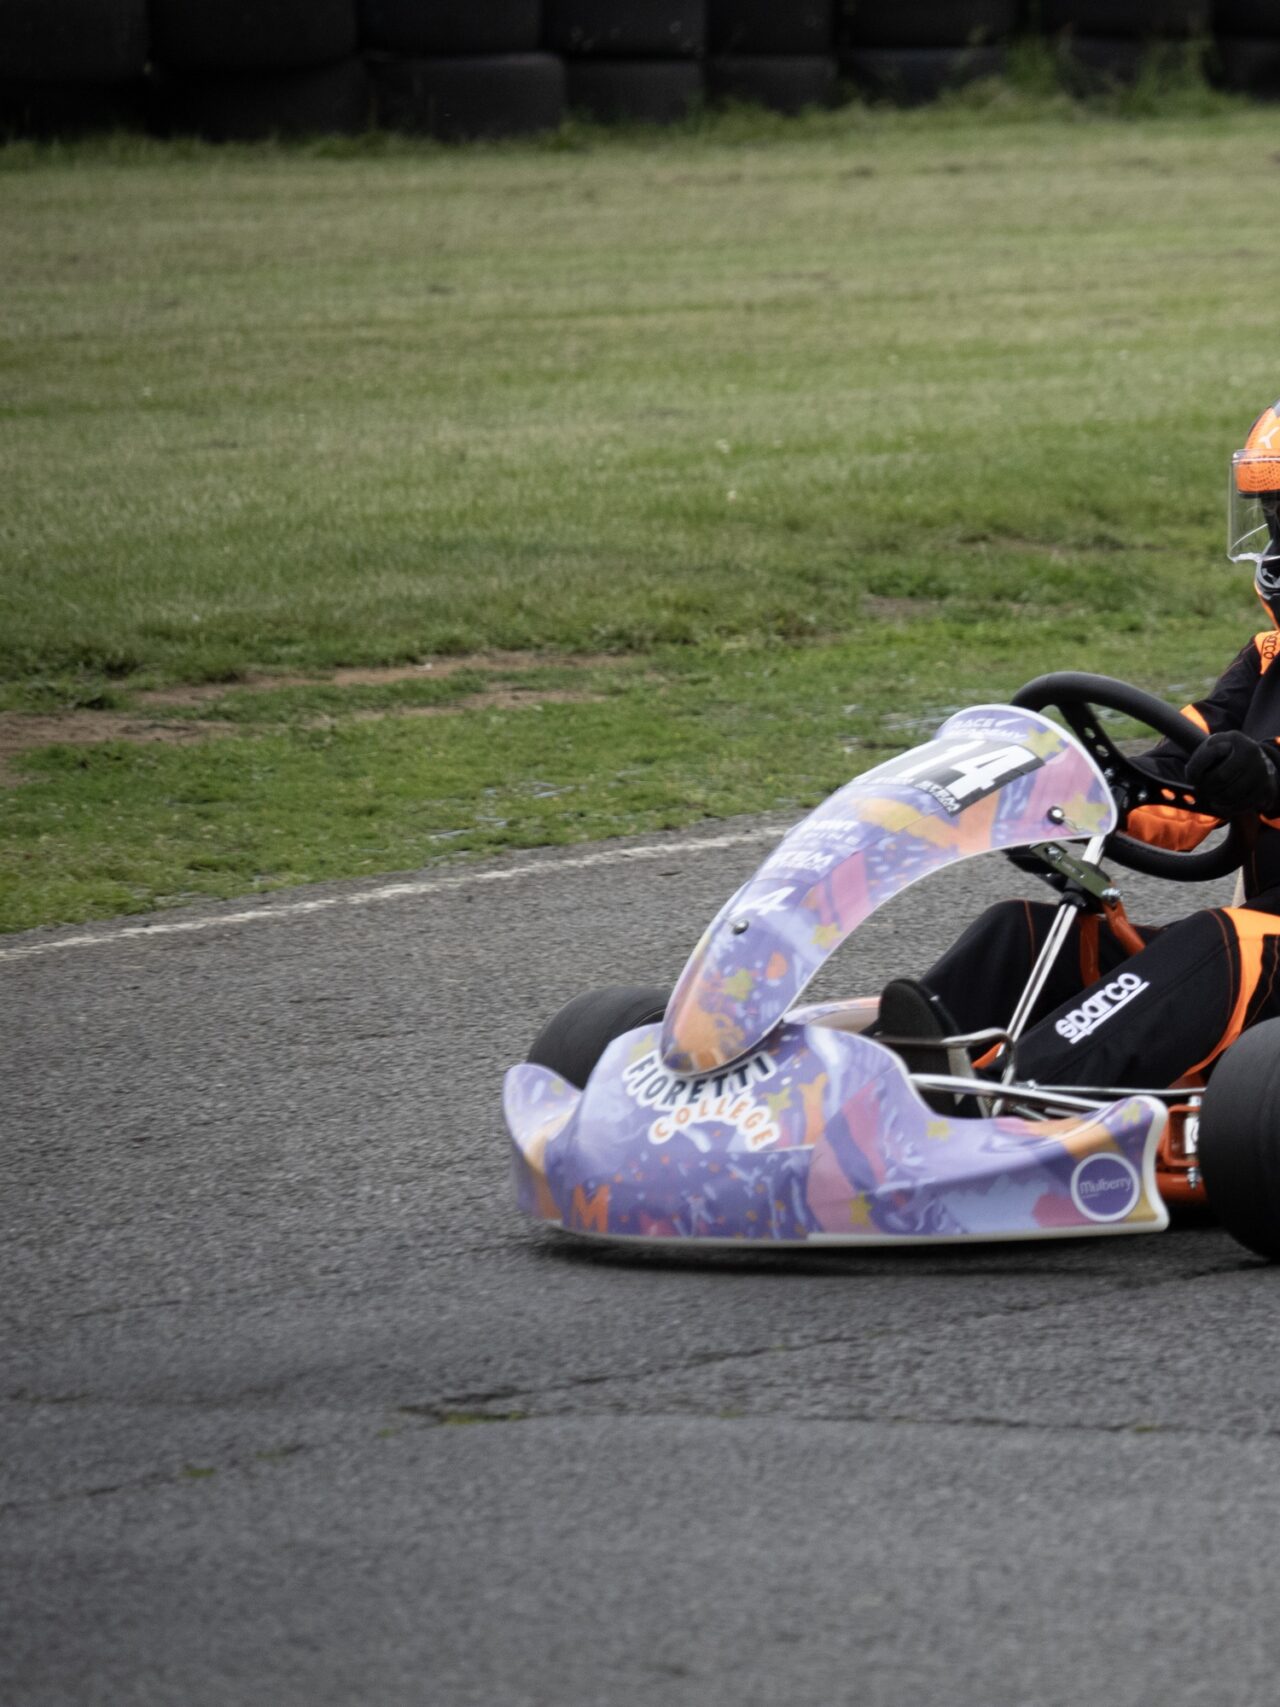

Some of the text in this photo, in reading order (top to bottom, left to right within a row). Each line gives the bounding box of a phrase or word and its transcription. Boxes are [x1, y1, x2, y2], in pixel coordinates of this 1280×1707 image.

[950, 718, 997, 729] RACE
[1055, 973, 1150, 1044] sparco
[626, 1055, 771, 1106] FIORETTI
[653, 1096, 775, 1146] COLLEGE
[1079, 1178, 1132, 1195] Mulberry
